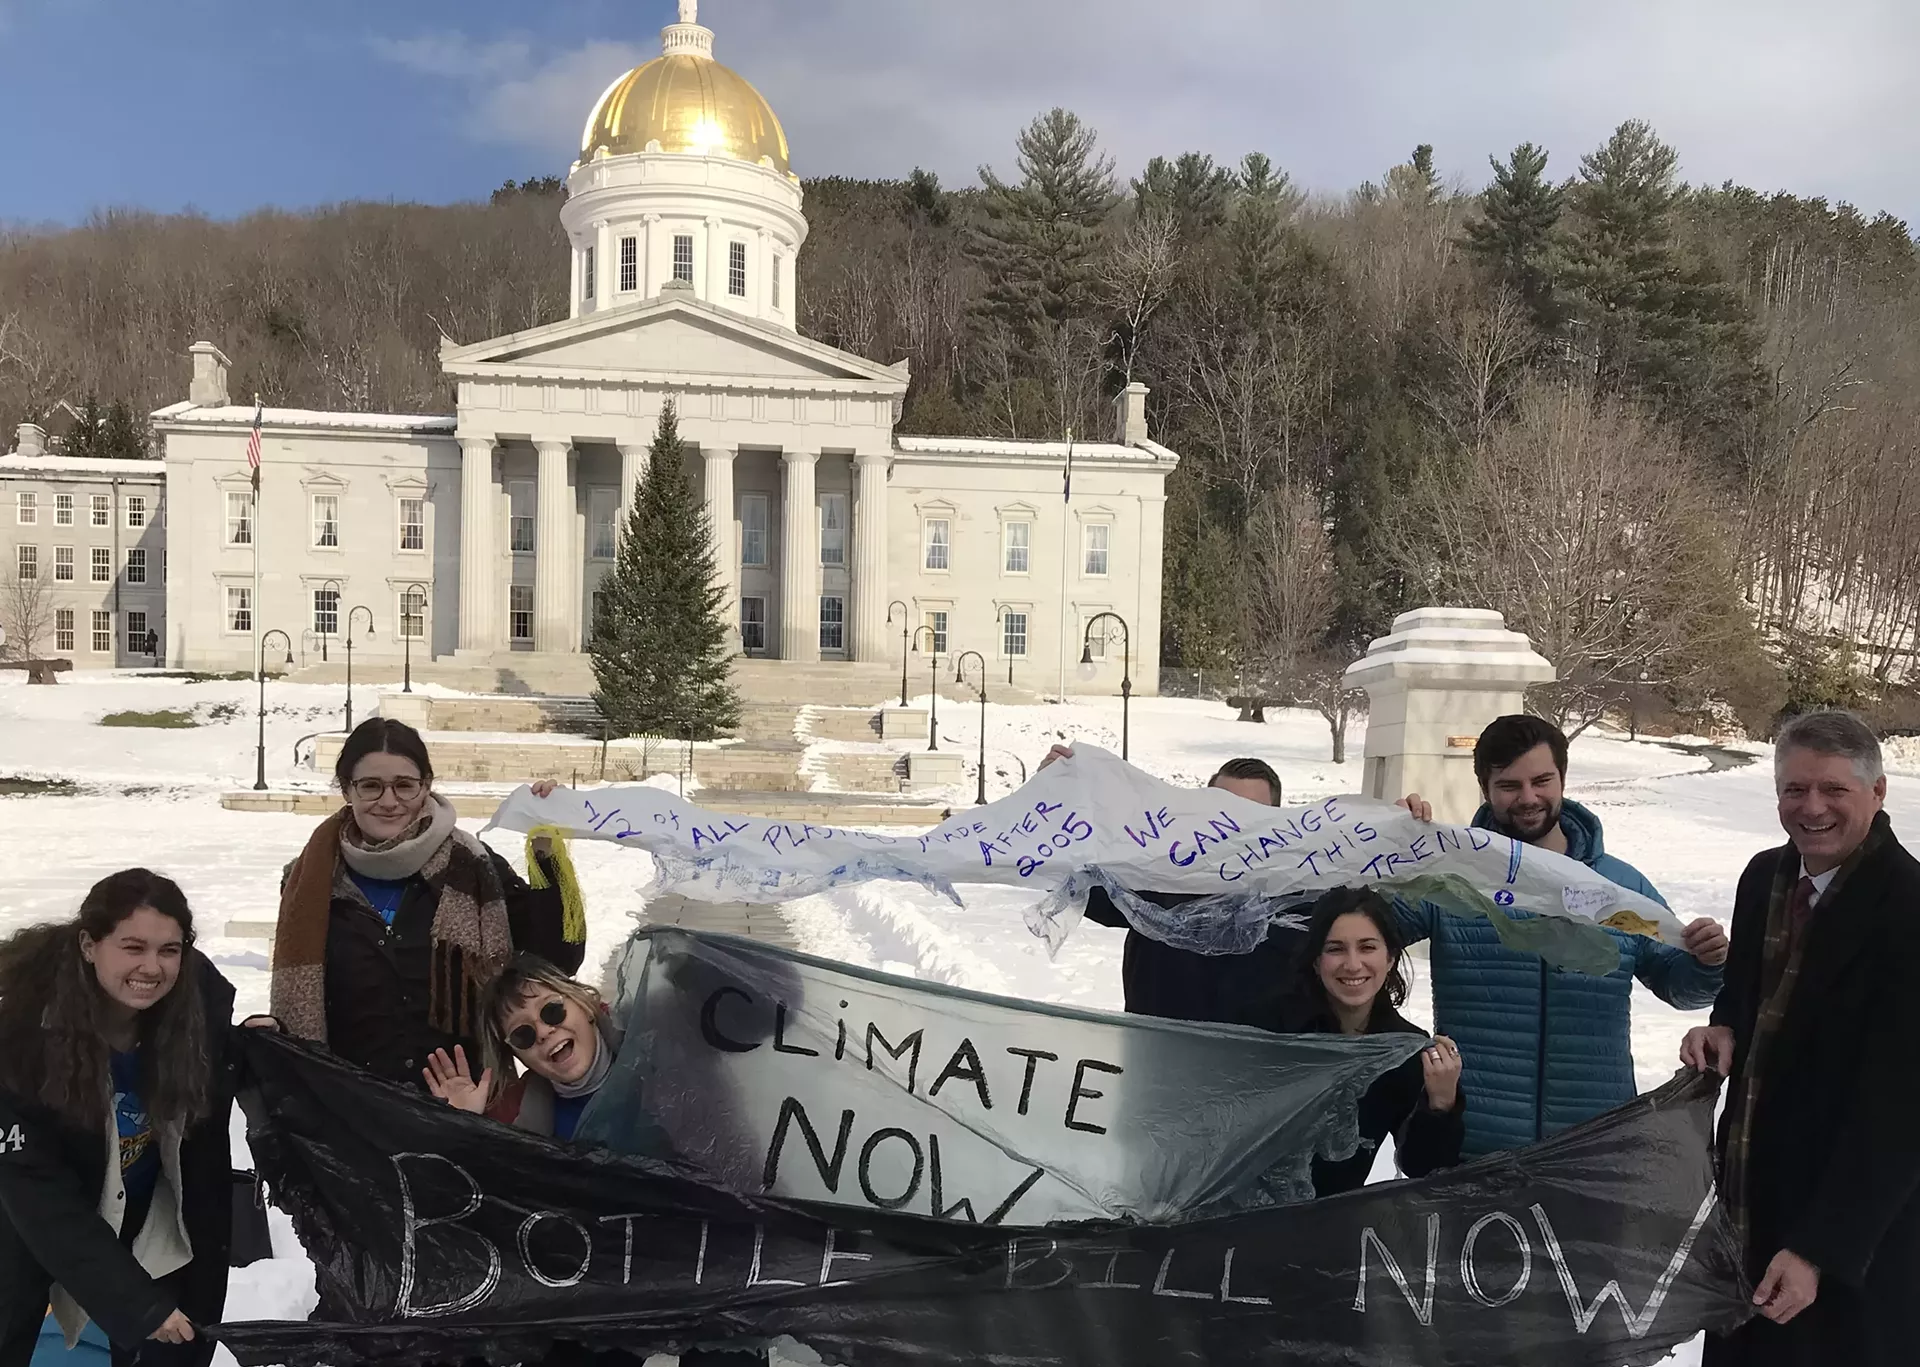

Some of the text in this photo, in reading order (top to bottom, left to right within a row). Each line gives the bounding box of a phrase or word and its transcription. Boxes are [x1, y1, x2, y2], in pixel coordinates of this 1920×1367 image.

[584, 800, 643, 839] 1/2
[692, 820, 750, 850] ALL
[917, 821, 988, 853] MADE
[980, 801, 1063, 866] AFTER
[1016, 812, 1093, 877] 2005
[1124, 806, 1176, 848] WE
[1169, 811, 1241, 866] CAN
[1219, 798, 1347, 881] CHANGE
[762, 1097, 1045, 1224] NOW
[1004, 1236, 1273, 1305] BILL
[1351, 1180, 1718, 1339] NOW
